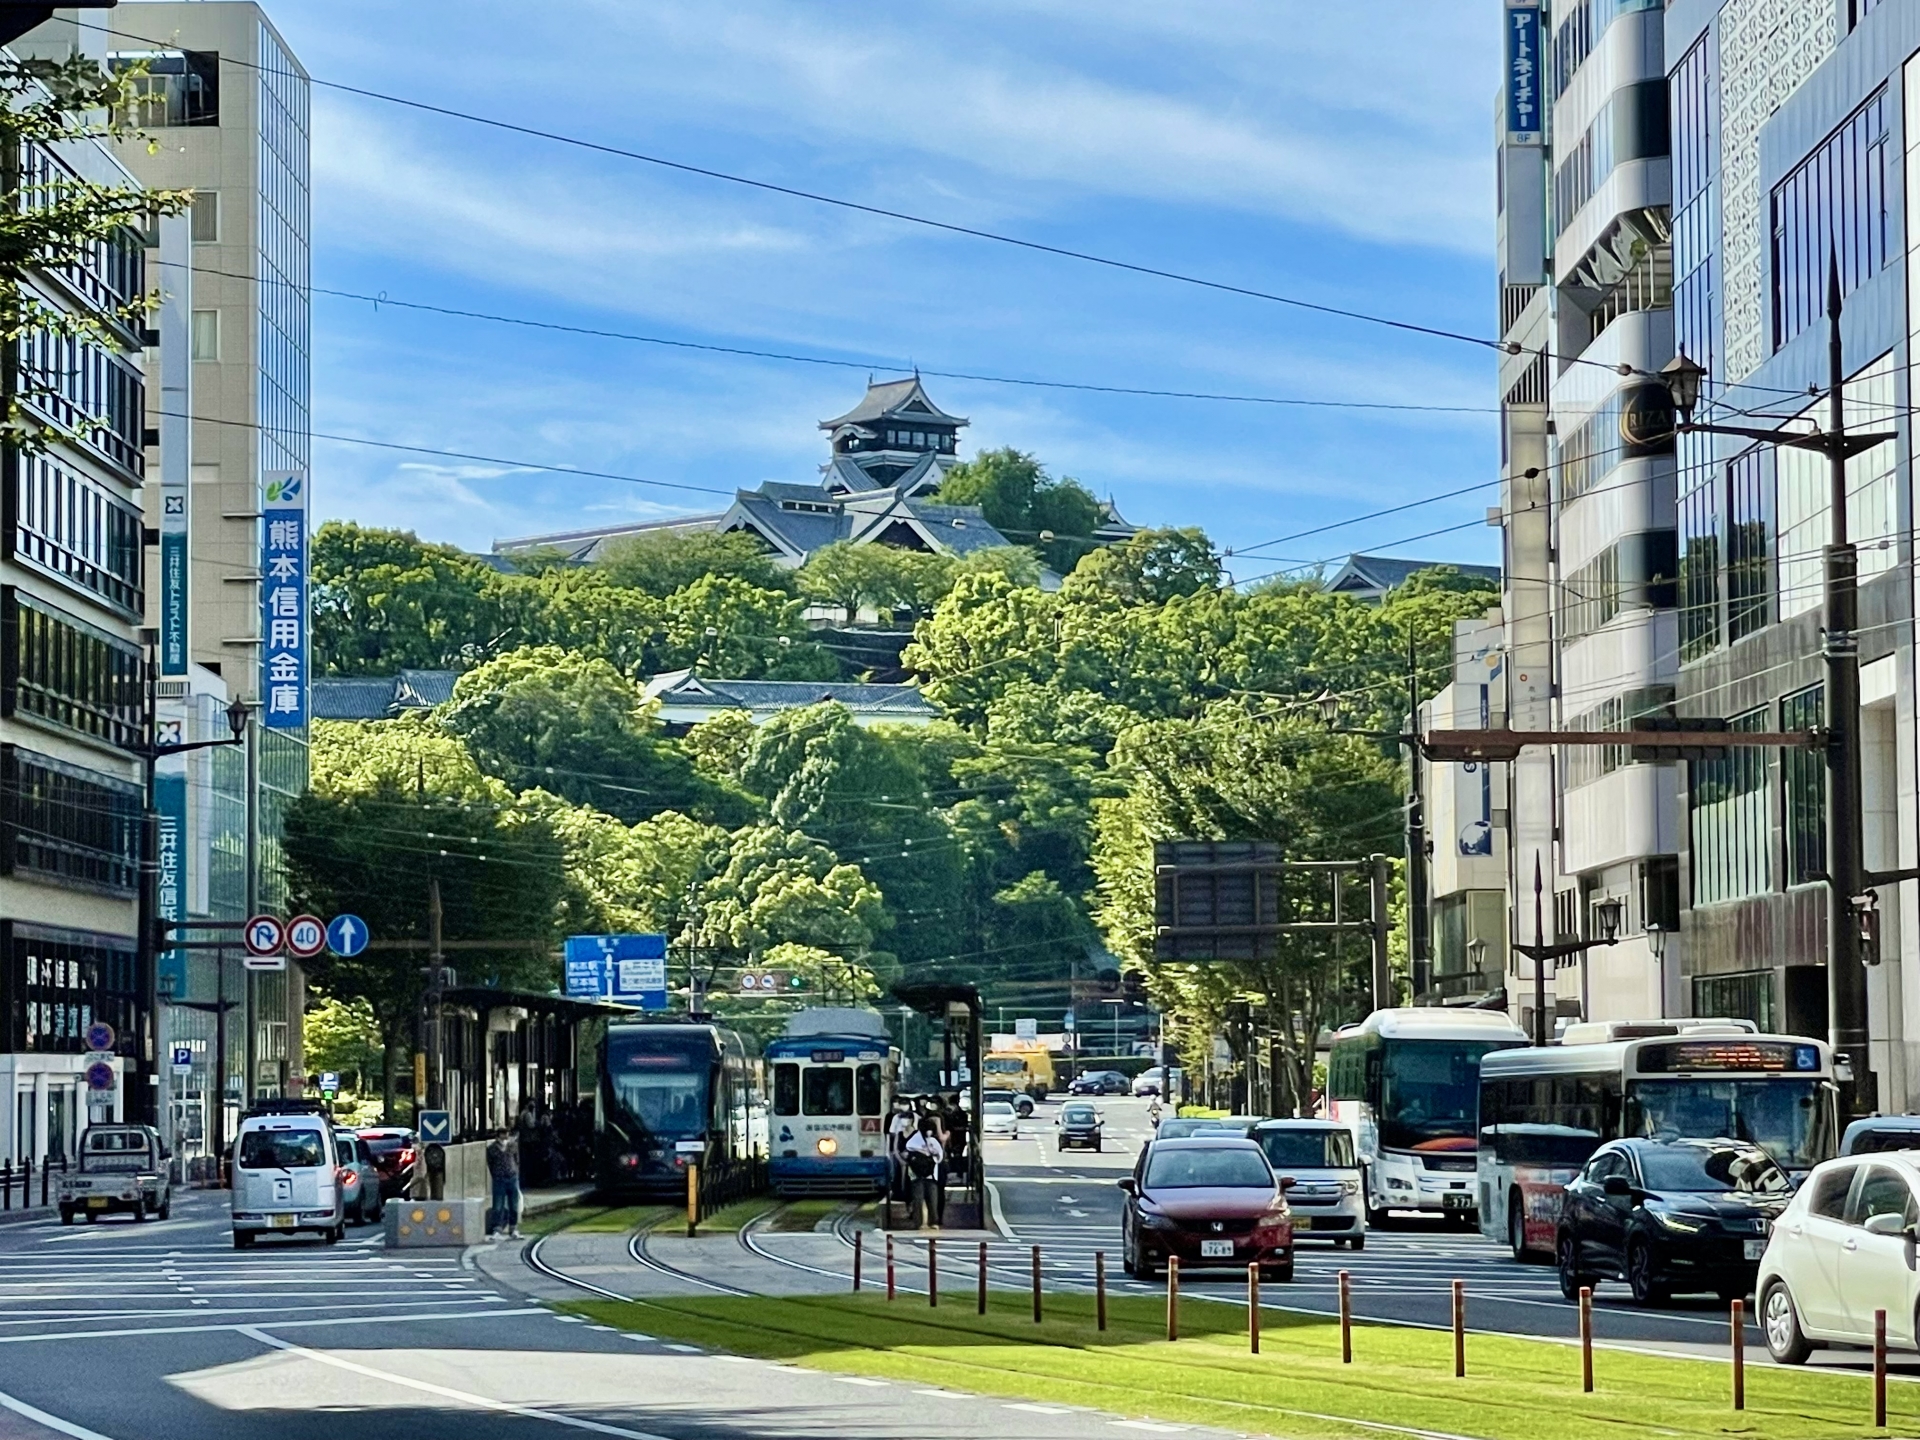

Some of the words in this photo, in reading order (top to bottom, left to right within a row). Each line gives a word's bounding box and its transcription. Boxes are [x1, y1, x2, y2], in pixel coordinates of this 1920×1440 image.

[1513, 13, 1533, 127] アートネイチャー
[1516, 133, 1531, 143] 8F
[168, 546, 181, 665] 三井住友トラスト不動産
[268, 519, 300, 715] 熊本信用金庫
[159, 815, 178, 960] 三井住友信託
[295, 927, 316, 945] 40
[865, 1120, 876, 1132] A
